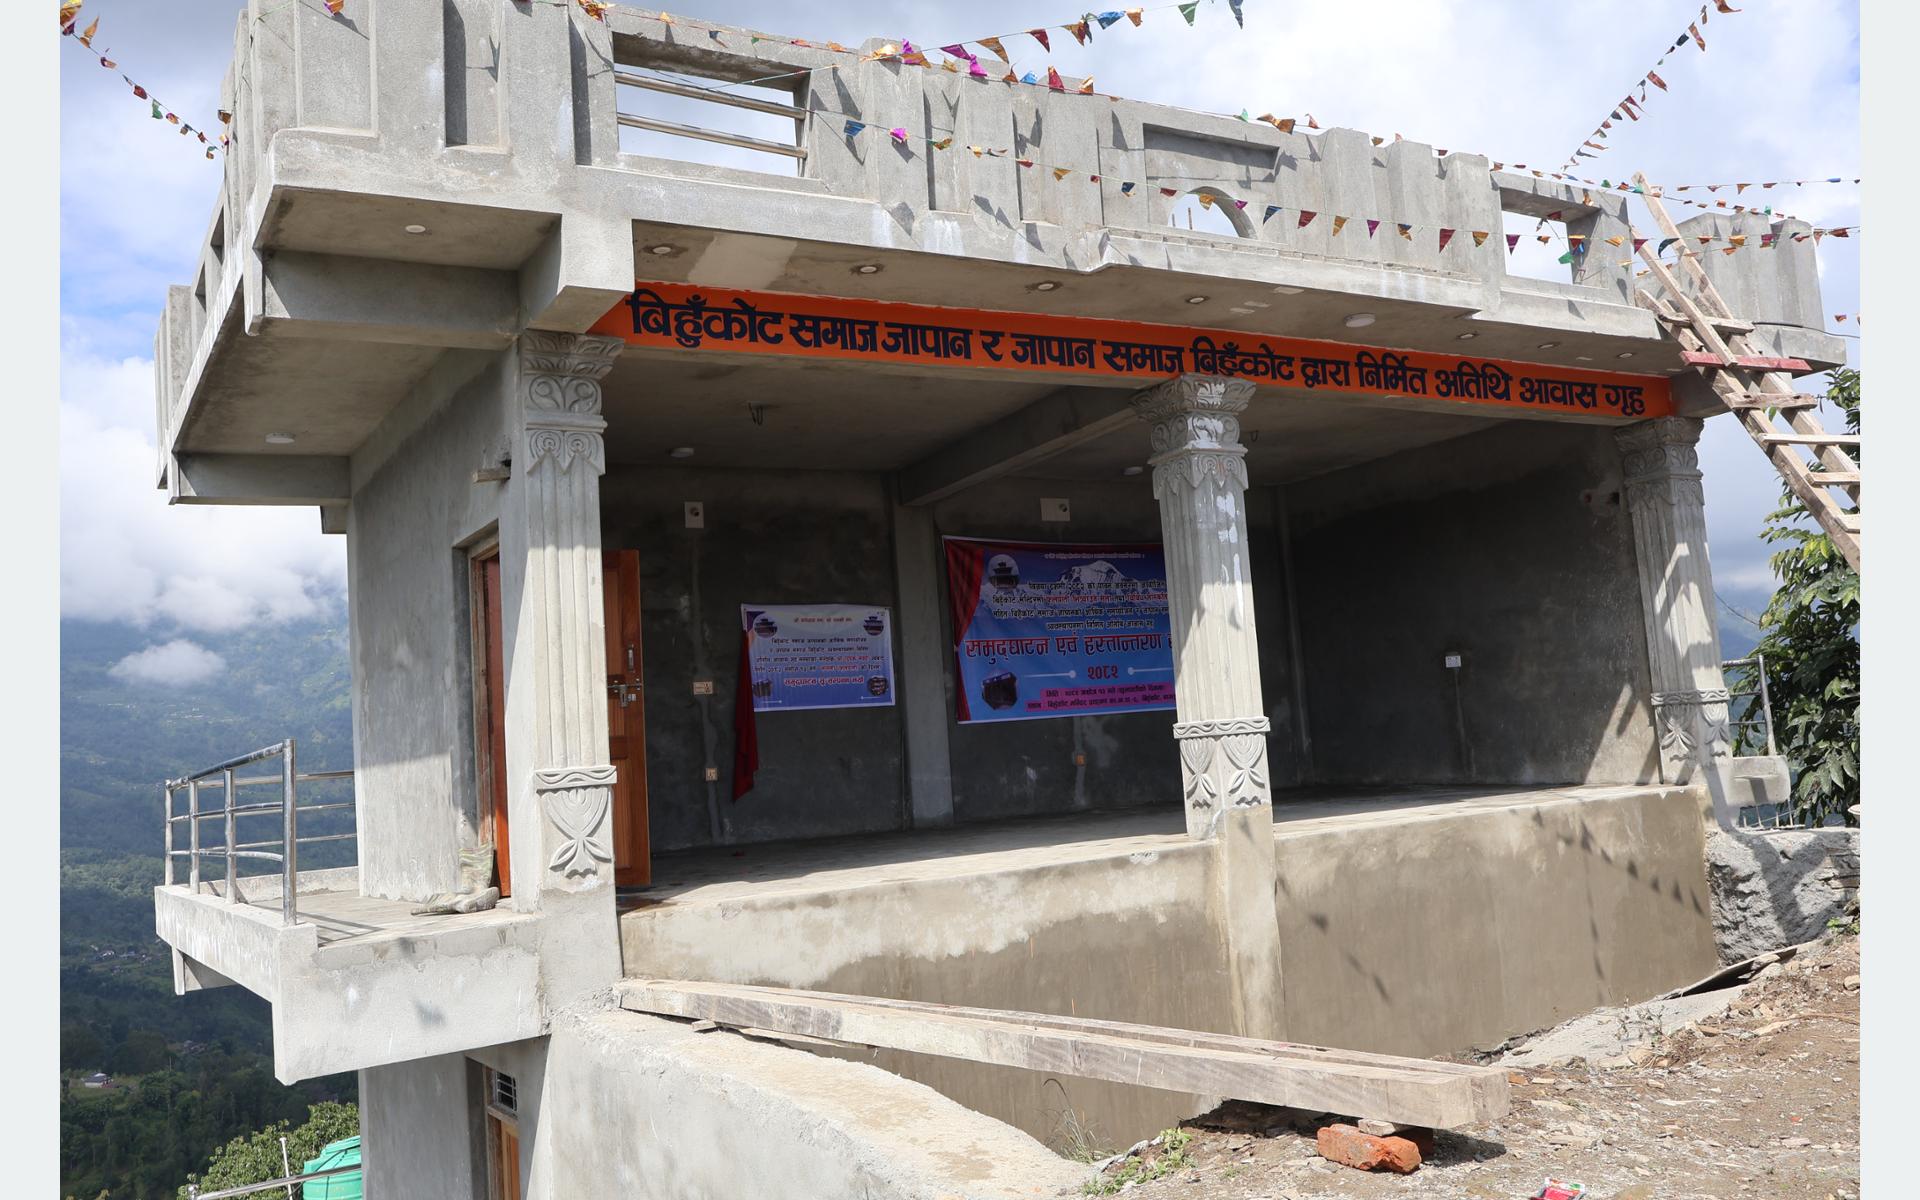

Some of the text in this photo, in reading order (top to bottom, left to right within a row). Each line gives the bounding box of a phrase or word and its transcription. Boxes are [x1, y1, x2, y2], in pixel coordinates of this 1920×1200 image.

[625, 288, 784, 348] बिहुँकोट
[789, 313, 879, 352] समाज
[882, 322, 973, 359] जापान
[980, 330, 1005, 362] र
[1010, 333, 1096, 369] जापान
[1101, 341, 1184, 374] समाज
[1300, 357, 1351, 388] द्वारा
[1355, 350, 1428, 395] निर्मित
[1434, 361, 1512, 401] अतिथि
[1519, 376, 1597, 408] आवास
[1602, 384, 1646, 416] गृह
[1055, 631, 1079, 656] एवं
[1084, 634, 1162, 656] हस्तान्तरण
[1087, 665, 1119, 680] २०८२
